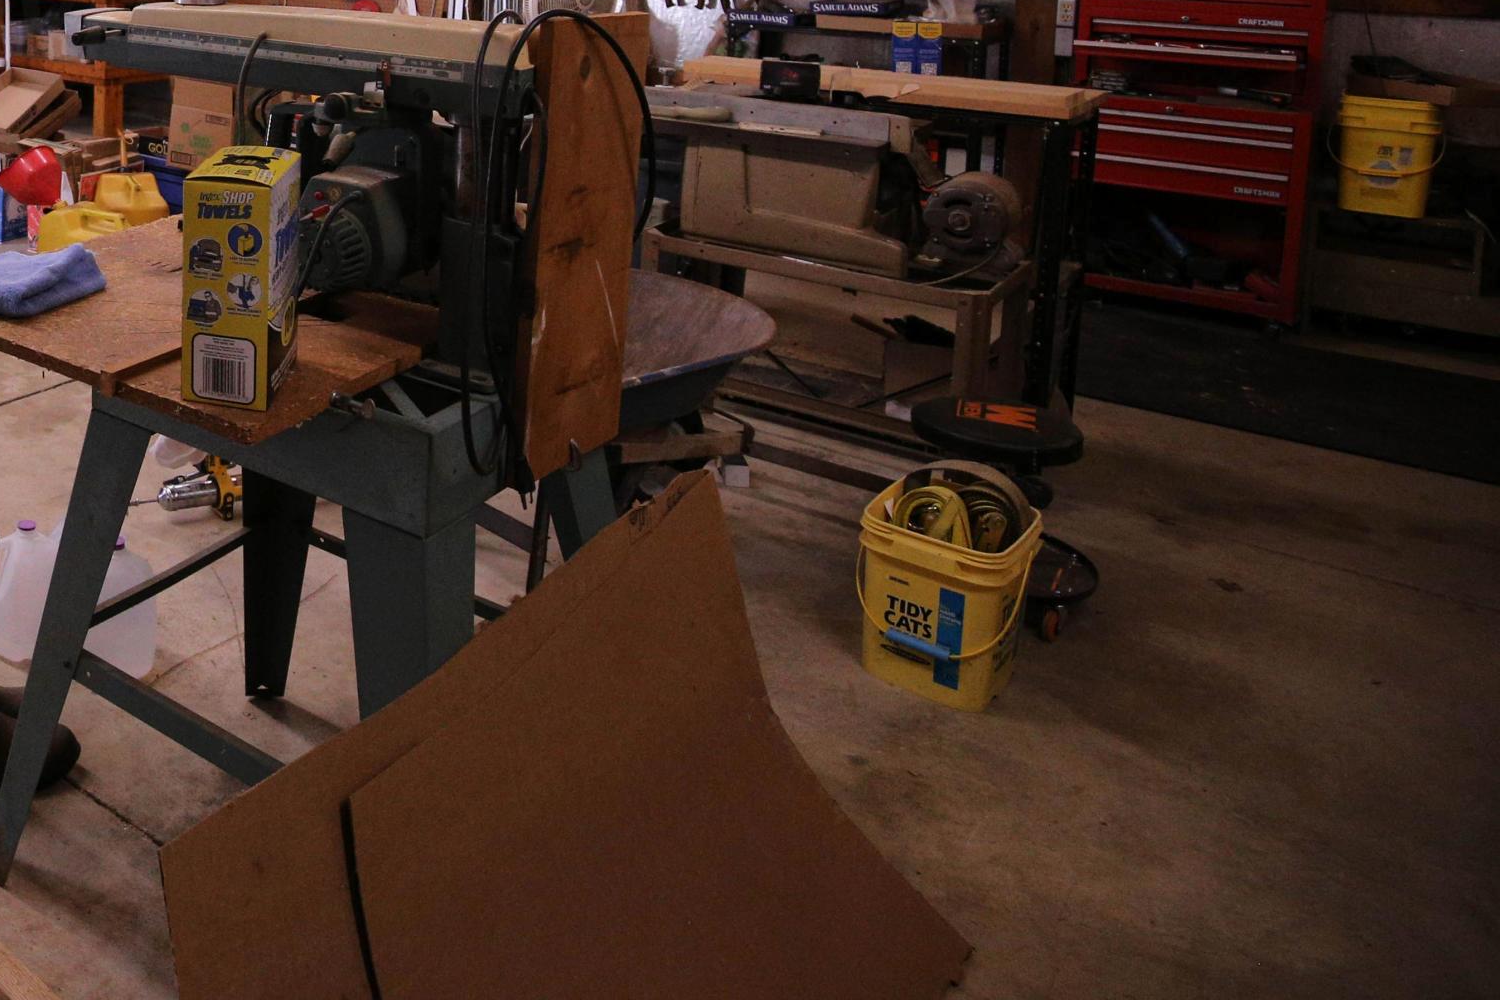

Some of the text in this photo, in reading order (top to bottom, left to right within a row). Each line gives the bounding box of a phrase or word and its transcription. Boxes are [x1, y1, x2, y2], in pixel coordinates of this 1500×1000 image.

[813, 2, 879, 13] SAMUEL ADAMS
[729, 12, 789, 25] SAMUEL ADAMS
[1238, 17, 1285, 28] CRAFTSMAN
[223, 190, 255, 204] SHOP
[1233, 186, 1280, 199] CRAFTSMAN
[197, 203, 253, 220] TOWELS
[887, 594, 933, 622] TIDY
[884, 610, 932, 639] CATS
